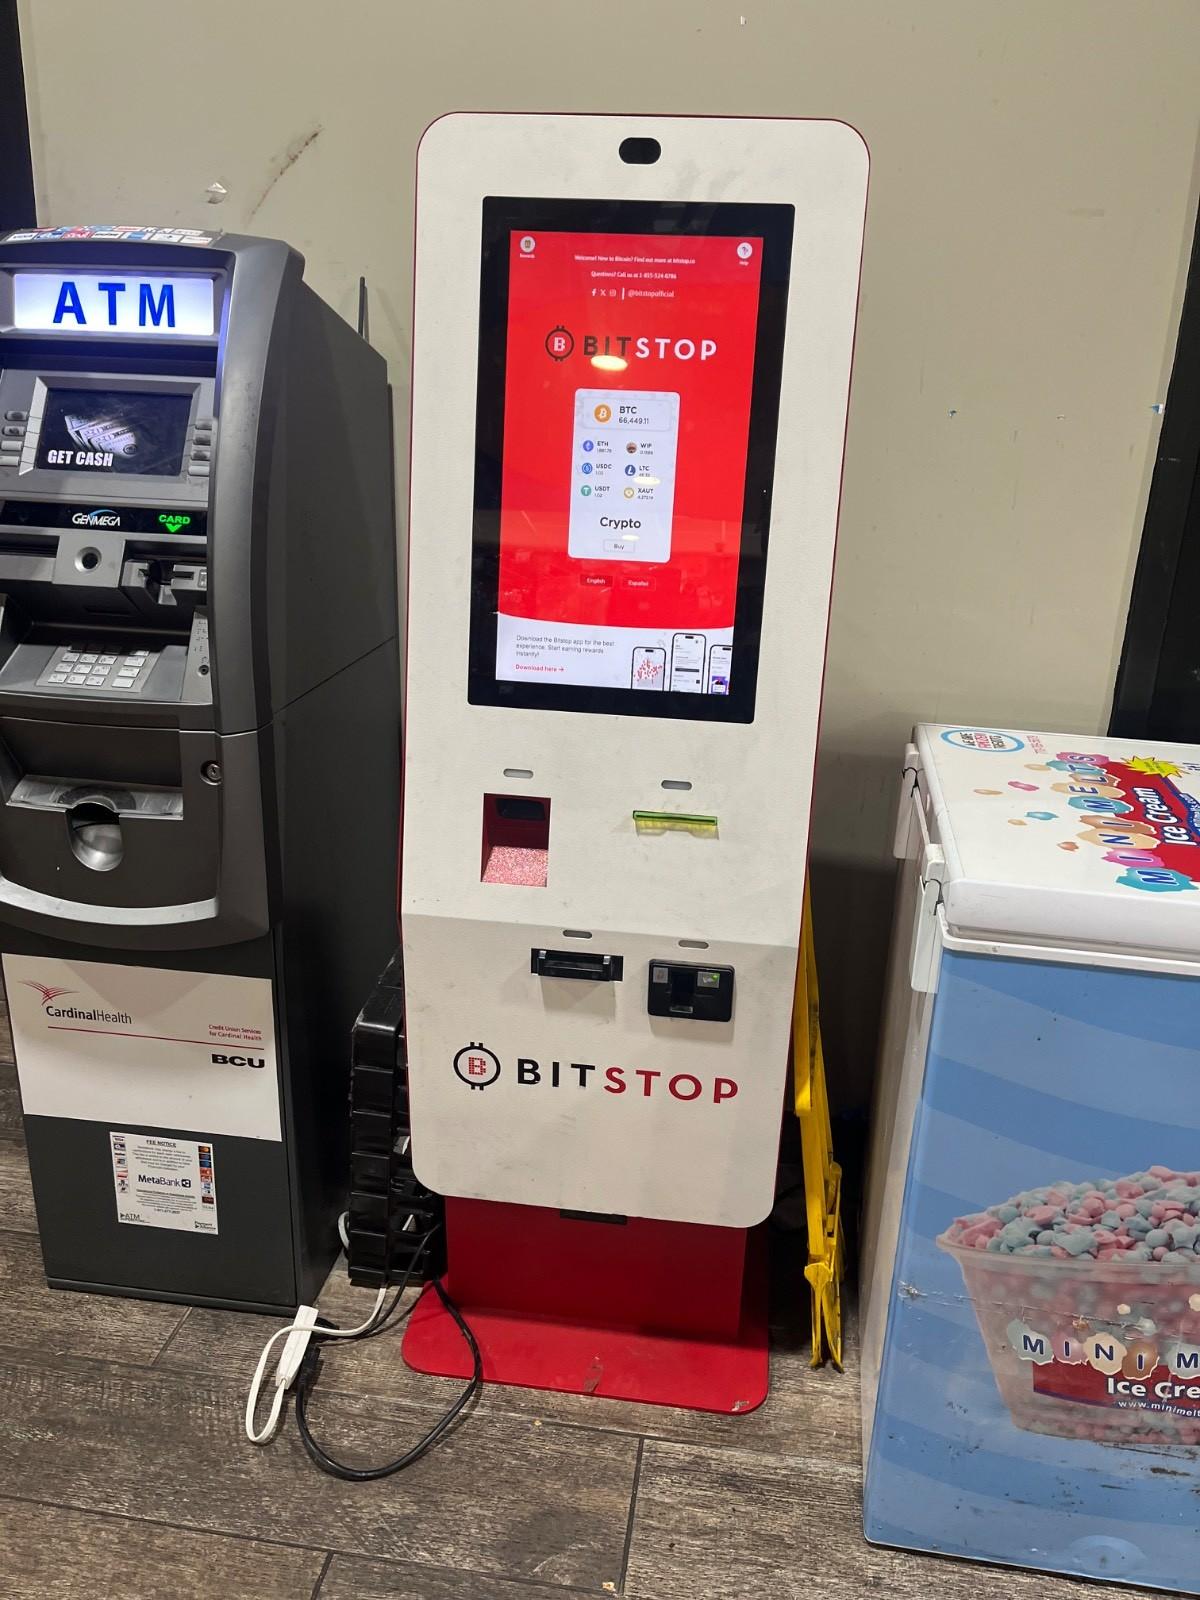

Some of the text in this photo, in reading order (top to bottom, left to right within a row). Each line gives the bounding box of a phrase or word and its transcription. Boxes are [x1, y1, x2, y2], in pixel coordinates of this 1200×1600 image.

[53, 281, 176, 328] ATM
[583, 335, 717, 361] BITSTOP
[619, 406, 638, 414] BTC
[47, 449, 114, 467] GET CASH
[72, 512, 120, 527] GENMEGA
[159, 514, 191, 525] CARD
[600, 517, 641, 530] Crypto
[586, 577, 605, 585] English
[1132, 787, 1178, 824] Cream
[1066, 753, 1179, 885] MINI MELTS
[1162, 825, 1198, 846] Ice
[46, 1005, 132, 1025] CardinalHealth
[217, 1031, 242, 1039] Cardinal
[211, 1053, 265, 1069] BCU
[517, 1058, 738, 1104] BITSTOP
[138, 1174, 181, 1188] MetaBank
[1022, 1334, 1144, 1371] MINI
[1107, 1377, 1147, 1397] Ice
